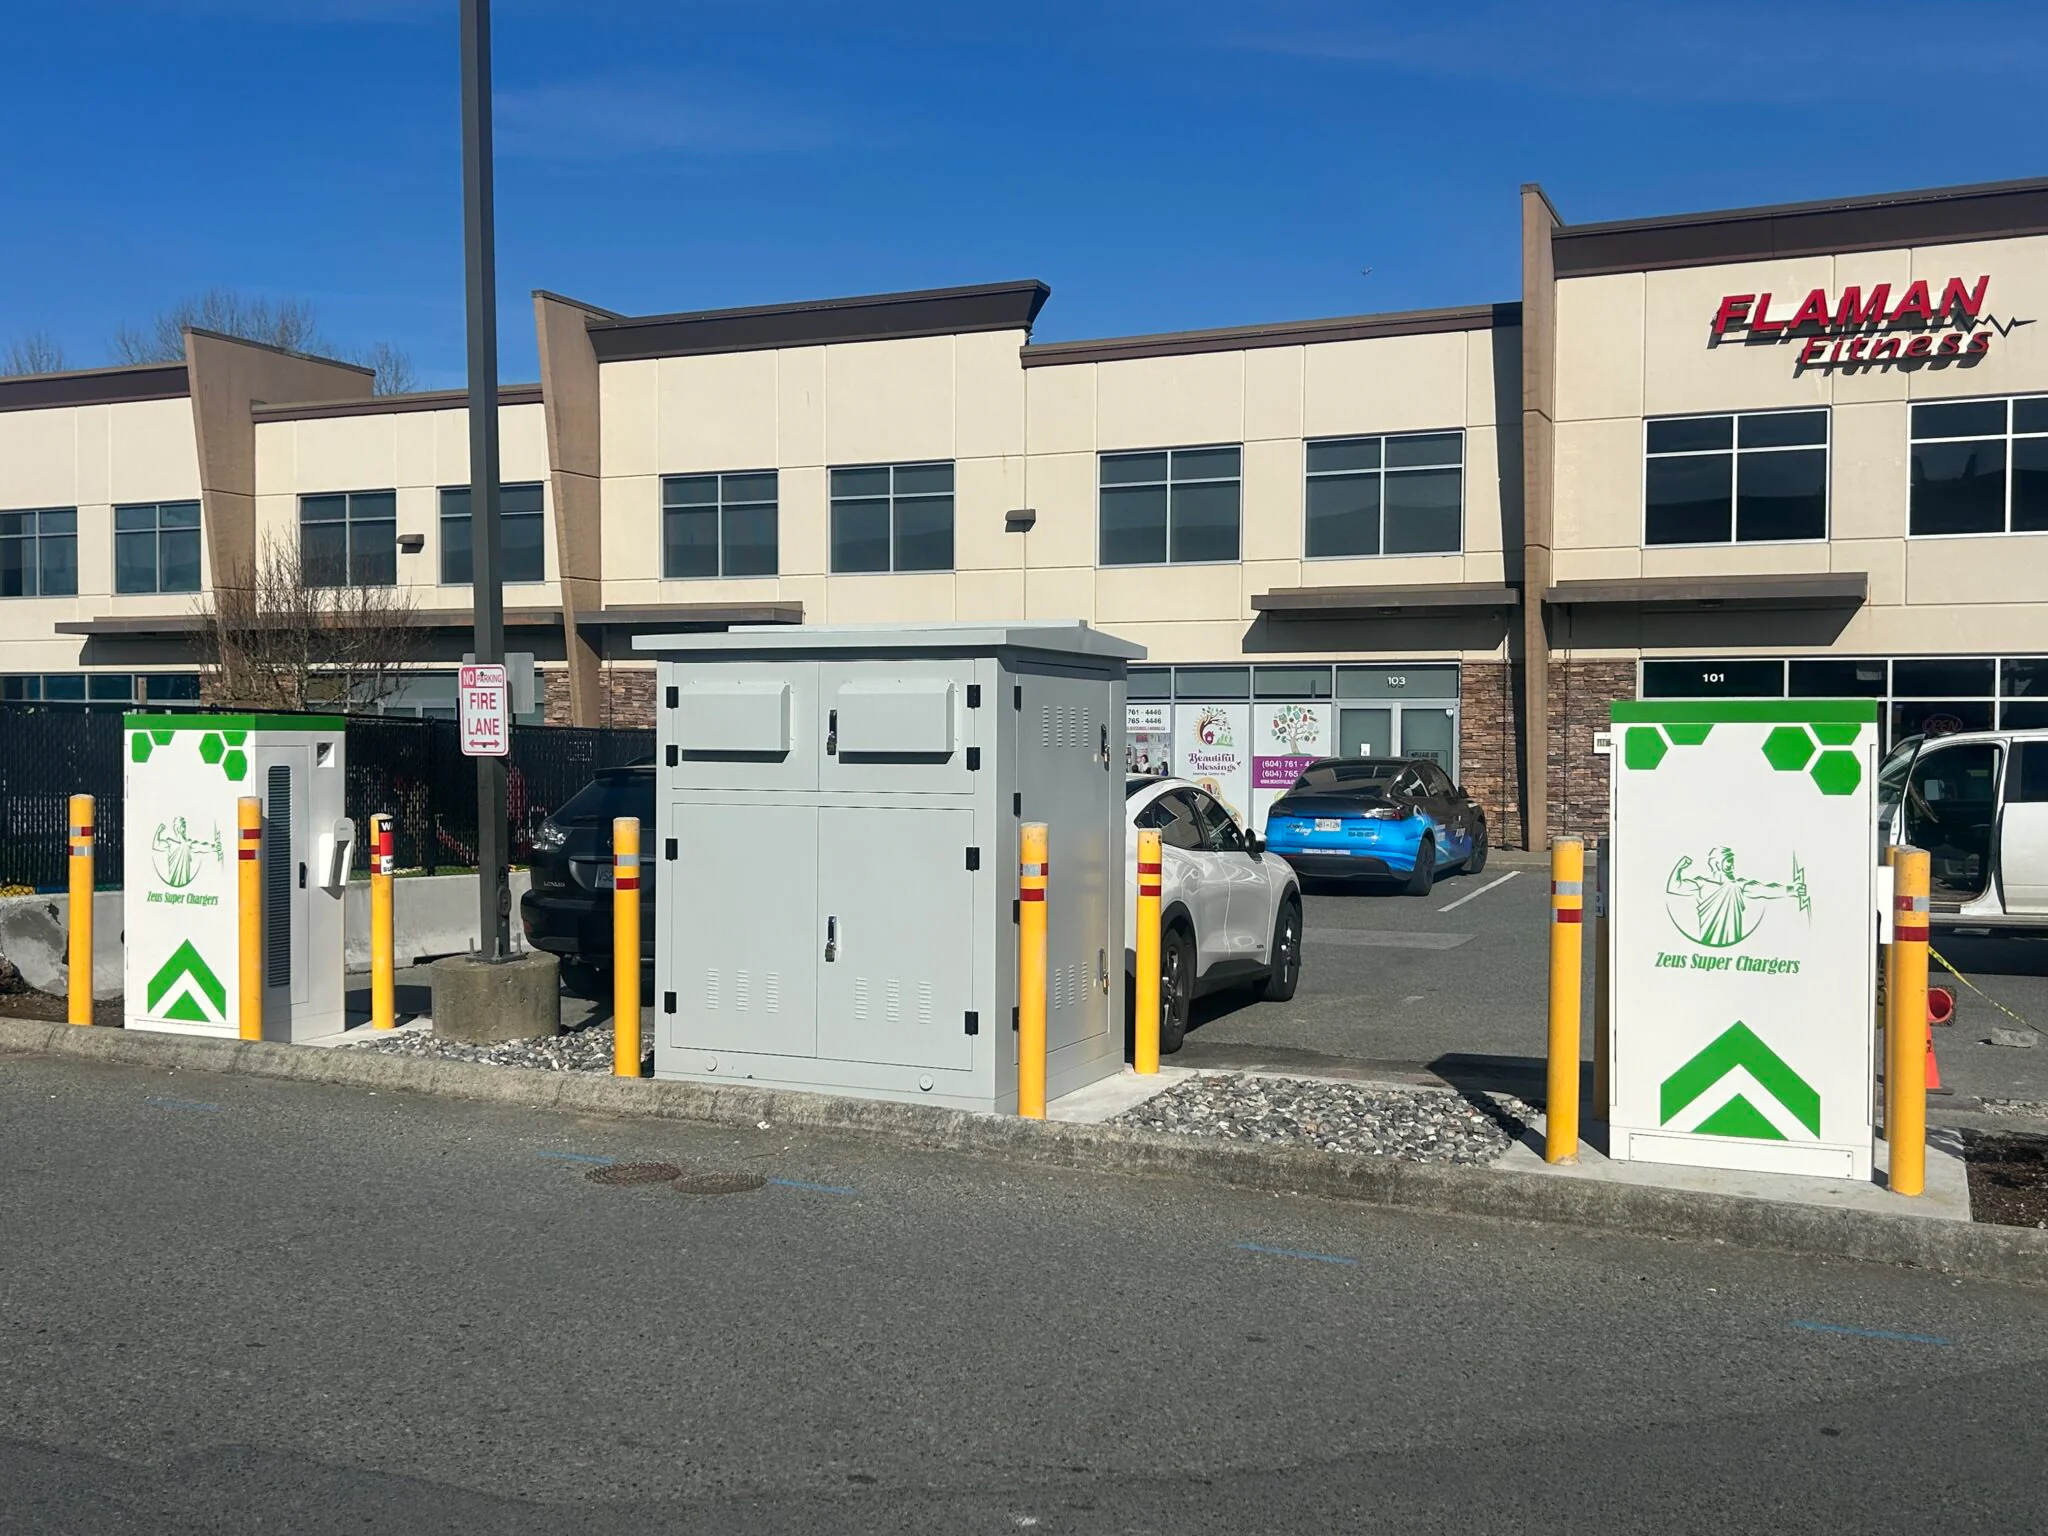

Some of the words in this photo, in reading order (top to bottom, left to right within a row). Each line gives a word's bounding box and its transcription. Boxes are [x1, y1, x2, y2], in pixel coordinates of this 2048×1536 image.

[1714, 275, 1991, 334] FLAMAN
[1801, 331, 1994, 365] Fitness
[463, 671, 475, 686] NO
[477, 675, 502, 683] PARKING
[1388, 676, 1406, 685] 103
[1702, 673, 1725, 682] 101
[469, 692, 497, 710] FIRE
[468, 718, 500, 736] LANE
[1188, 752, 1235, 764] Beautiful
[1261, 760, 1282, 769] (604)
[1284, 760, 1298, 768] 761
[1196, 763, 1237, 773] blessings
[1261, 770, 1282, 779] (604)
[1284, 770, 1299, 778] 765
[147, 891, 163, 902] Zeus
[164, 892, 185, 905] Super
[186, 893, 219, 906] Chargers
[1654, 951, 1687, 969] Zeus
[1690, 953, 1733, 972] Super
[1735, 955, 1801, 975] Chargers
